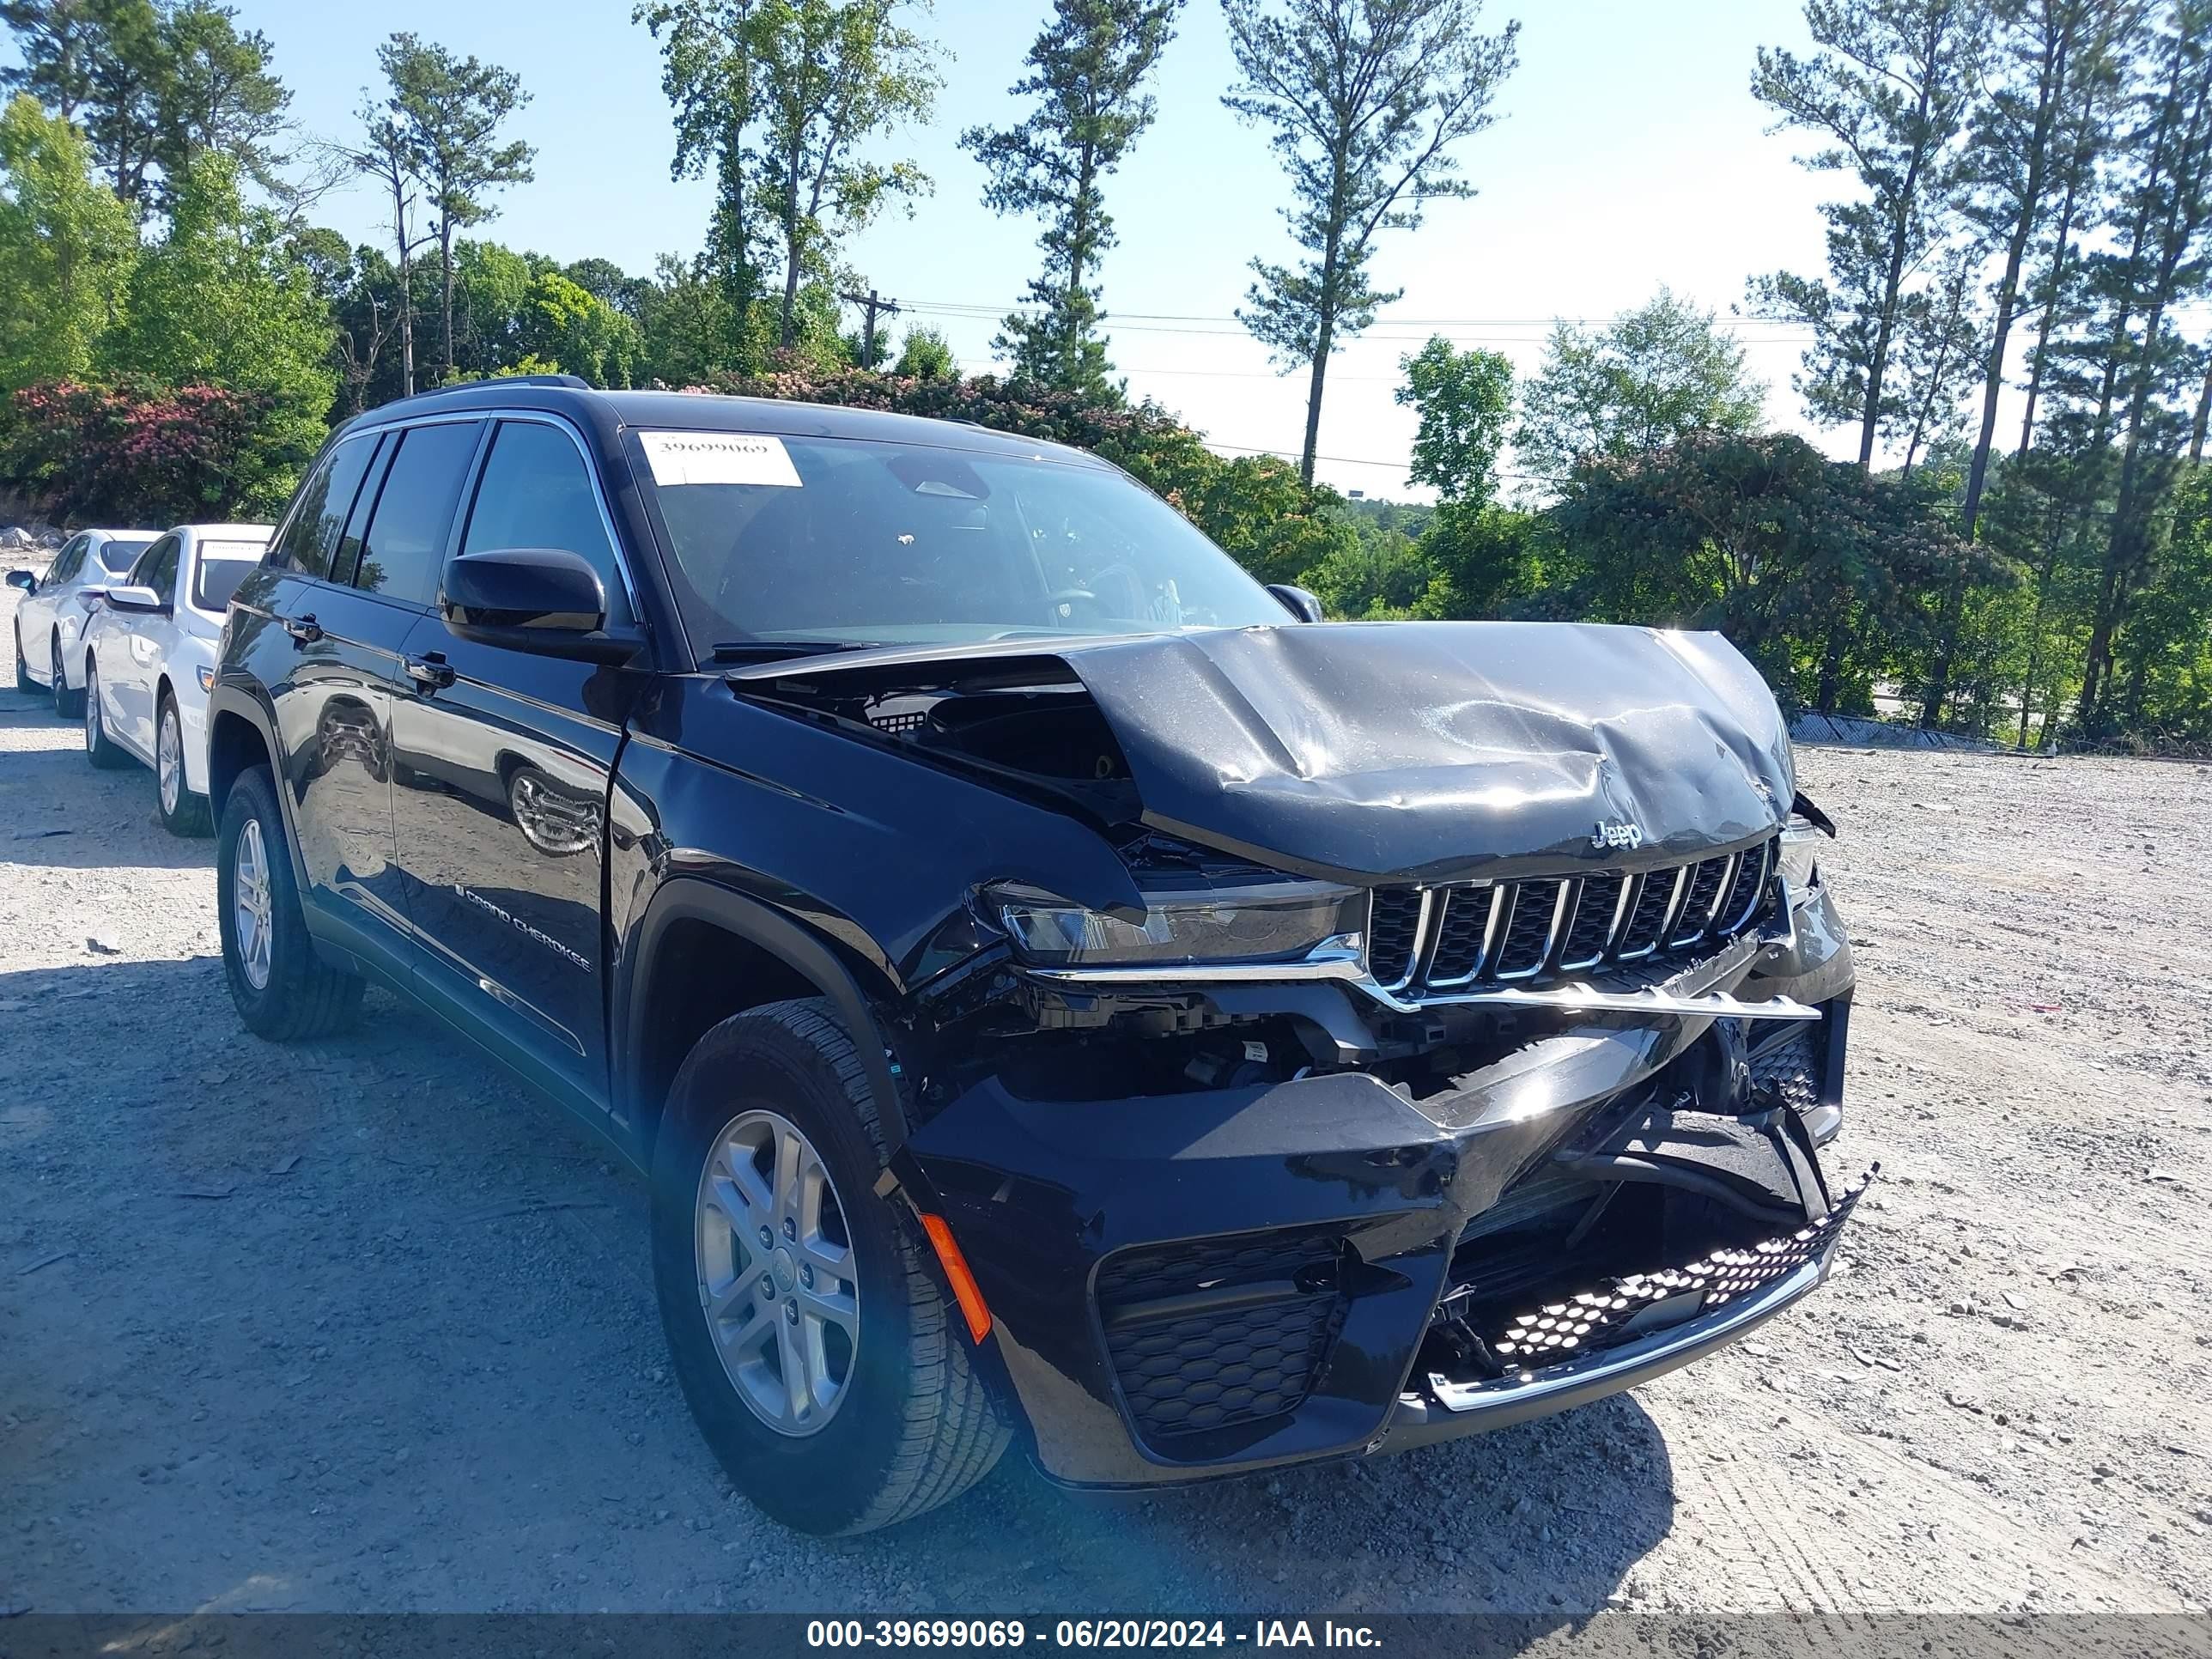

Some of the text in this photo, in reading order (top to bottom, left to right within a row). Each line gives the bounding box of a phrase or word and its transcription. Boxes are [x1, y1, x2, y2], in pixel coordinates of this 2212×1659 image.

[659, 442, 769, 453] 39699069
[1591, 821, 1643, 849] Jeep
[465, 890, 593, 974] GRAND CHEROKEE
